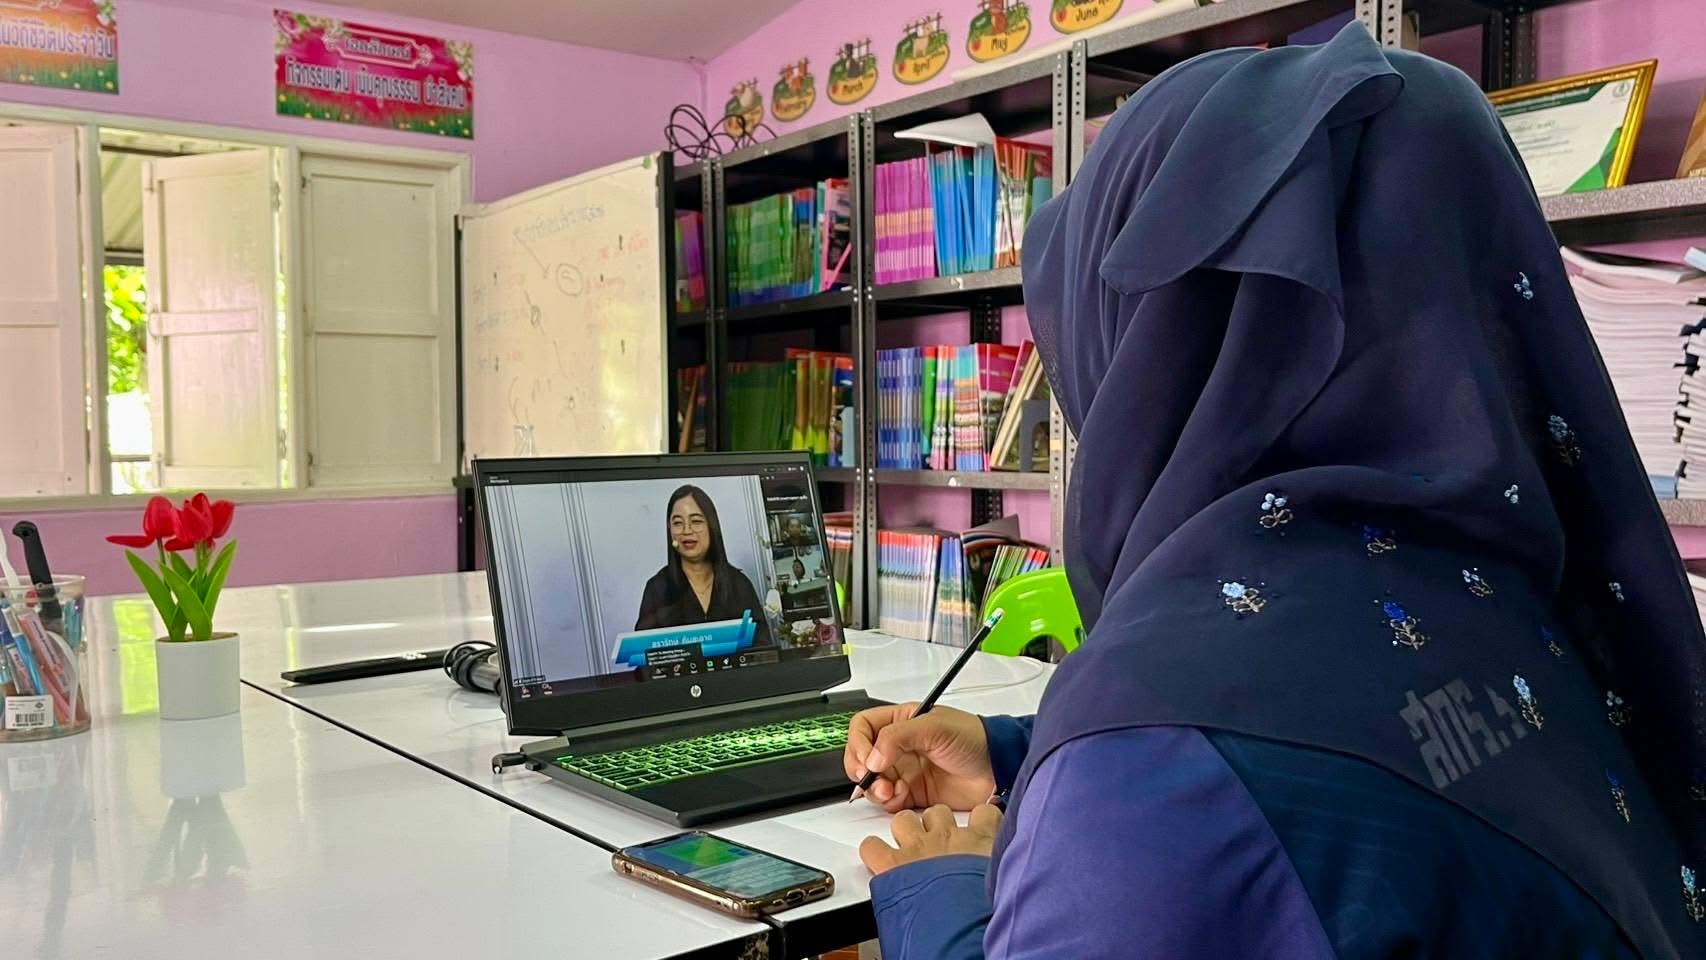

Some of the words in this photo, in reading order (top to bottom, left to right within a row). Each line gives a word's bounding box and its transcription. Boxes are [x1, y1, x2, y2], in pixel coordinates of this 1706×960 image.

[0, 16, 114, 58] นวิถีชีวิตประจำวัน
